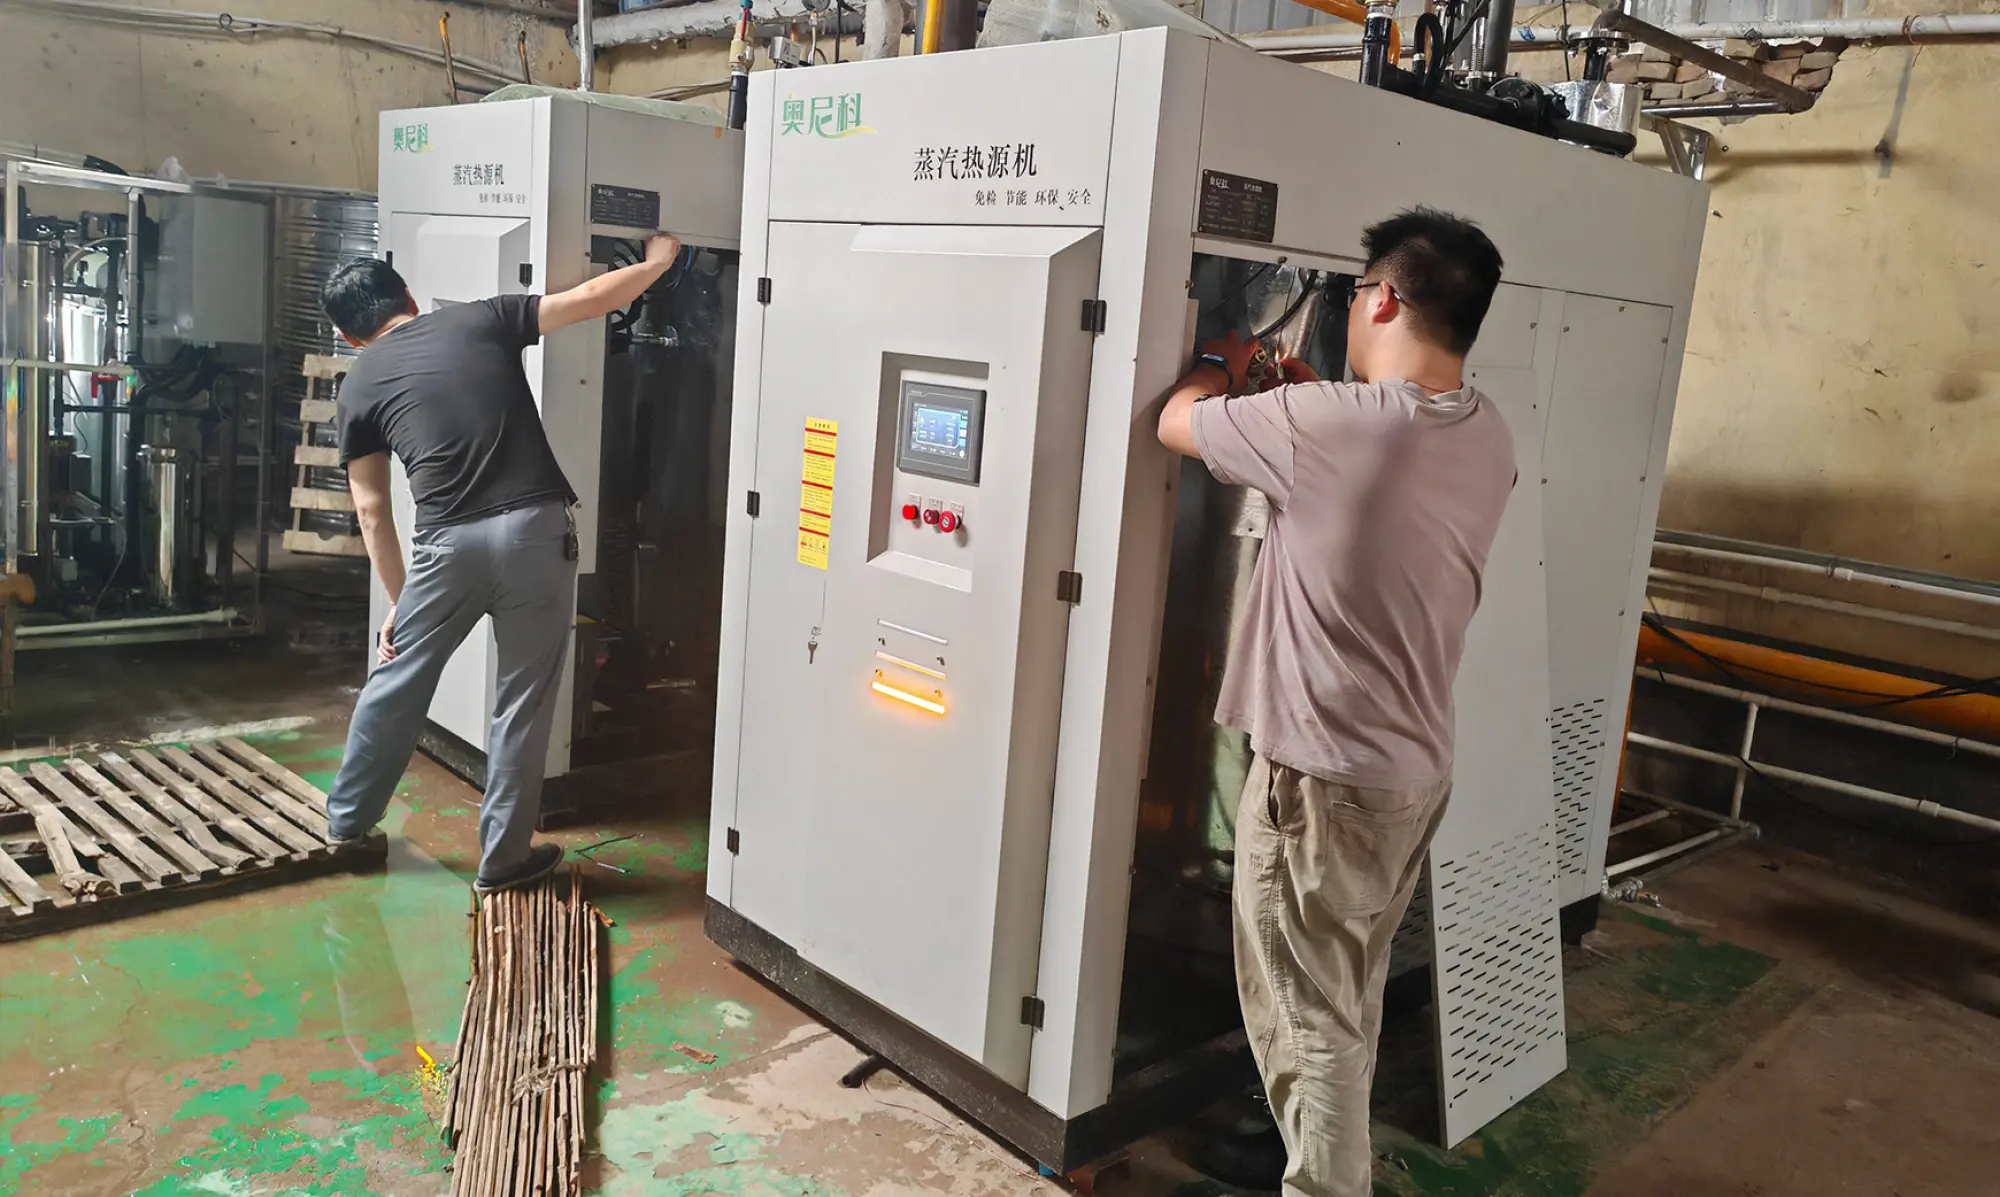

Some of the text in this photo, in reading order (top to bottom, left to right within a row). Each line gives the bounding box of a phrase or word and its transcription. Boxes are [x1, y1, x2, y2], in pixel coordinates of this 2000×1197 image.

[781, 91, 870, 139] 奥尼科
[393, 123, 431, 153] 奥尼科
[453, 164, 504, 186] 蒸汽热源机
[913, 143, 1038, 181] 蒸汽热源机
[975, 187, 1092, 206] 免检 节能 环保 安全
